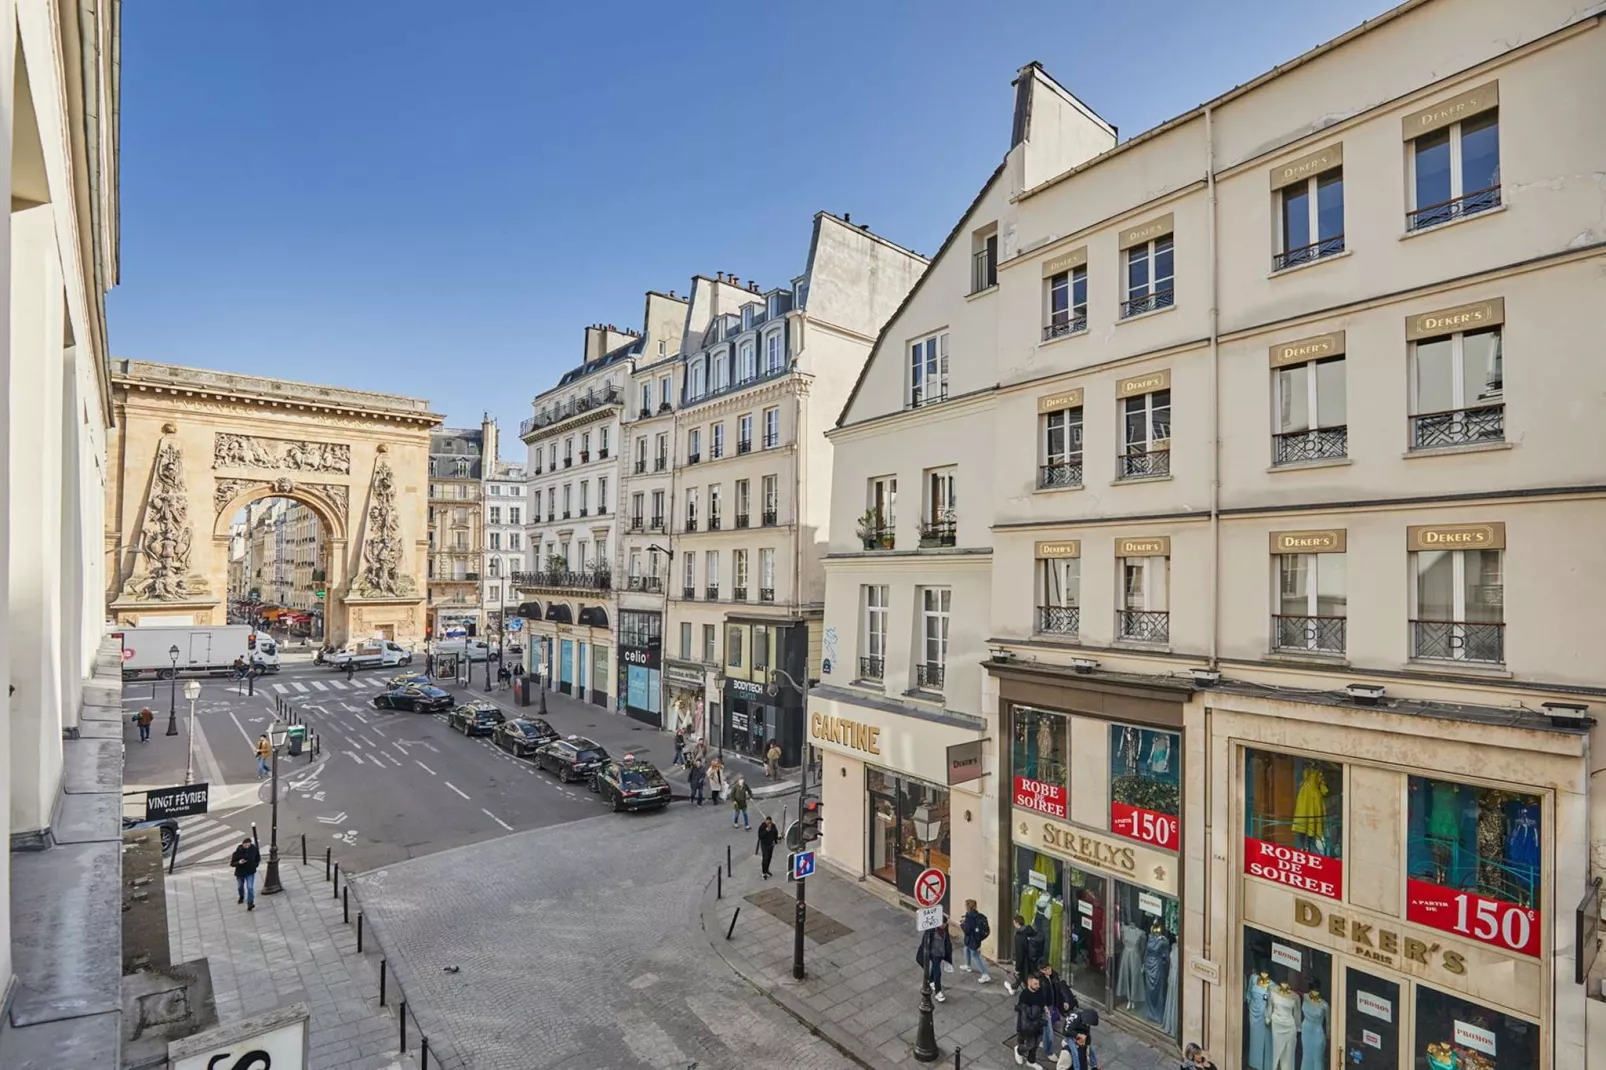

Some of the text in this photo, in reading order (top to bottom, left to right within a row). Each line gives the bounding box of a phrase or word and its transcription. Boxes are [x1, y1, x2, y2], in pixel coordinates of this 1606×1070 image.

[1421, 99, 1477, 125] DEKER'S
[1284, 156, 1328, 178] DEKER'S
[1425, 311, 1482, 329] DEKER'S
[1284, 342, 1329, 358] DEKER'S
[1126, 378, 1159, 391] DEKER'S
[1285, 536, 1330, 547] DEKER'S
[1427, 531, 1484, 543] DEKER'S
[1043, 545, 1071, 554] DEKER'S
[1125, 543, 1159, 552] DEKER'S
[624, 650, 646, 664] celio
[733, 680, 763, 694] BODYTECH
[811, 712, 881, 755] CANTINE
[953, 757, 978, 769] DEKER'S
[1021, 778, 1059, 799] ROBE
[148, 791, 206, 809] VINGT FÉVRIER
[1017, 794, 1065, 817] SOIREE
[1042, 822, 1136, 871] SIRELYS
[1260, 842, 1323, 869] ROBE
[1278, 860, 1302, 874] DE
[1250, 862, 1335, 896] SOIREE
[1419, 900, 1449, 908] PARTIR
[1295, 897, 1467, 975] DEKER'S
[1273, 948, 1300, 964] PROMOS
[1355, 946, 1393, 965] PARIS
[1359, 997, 1390, 1013] PROMOS
[1456, 1028, 1494, 1046] PROMOS
